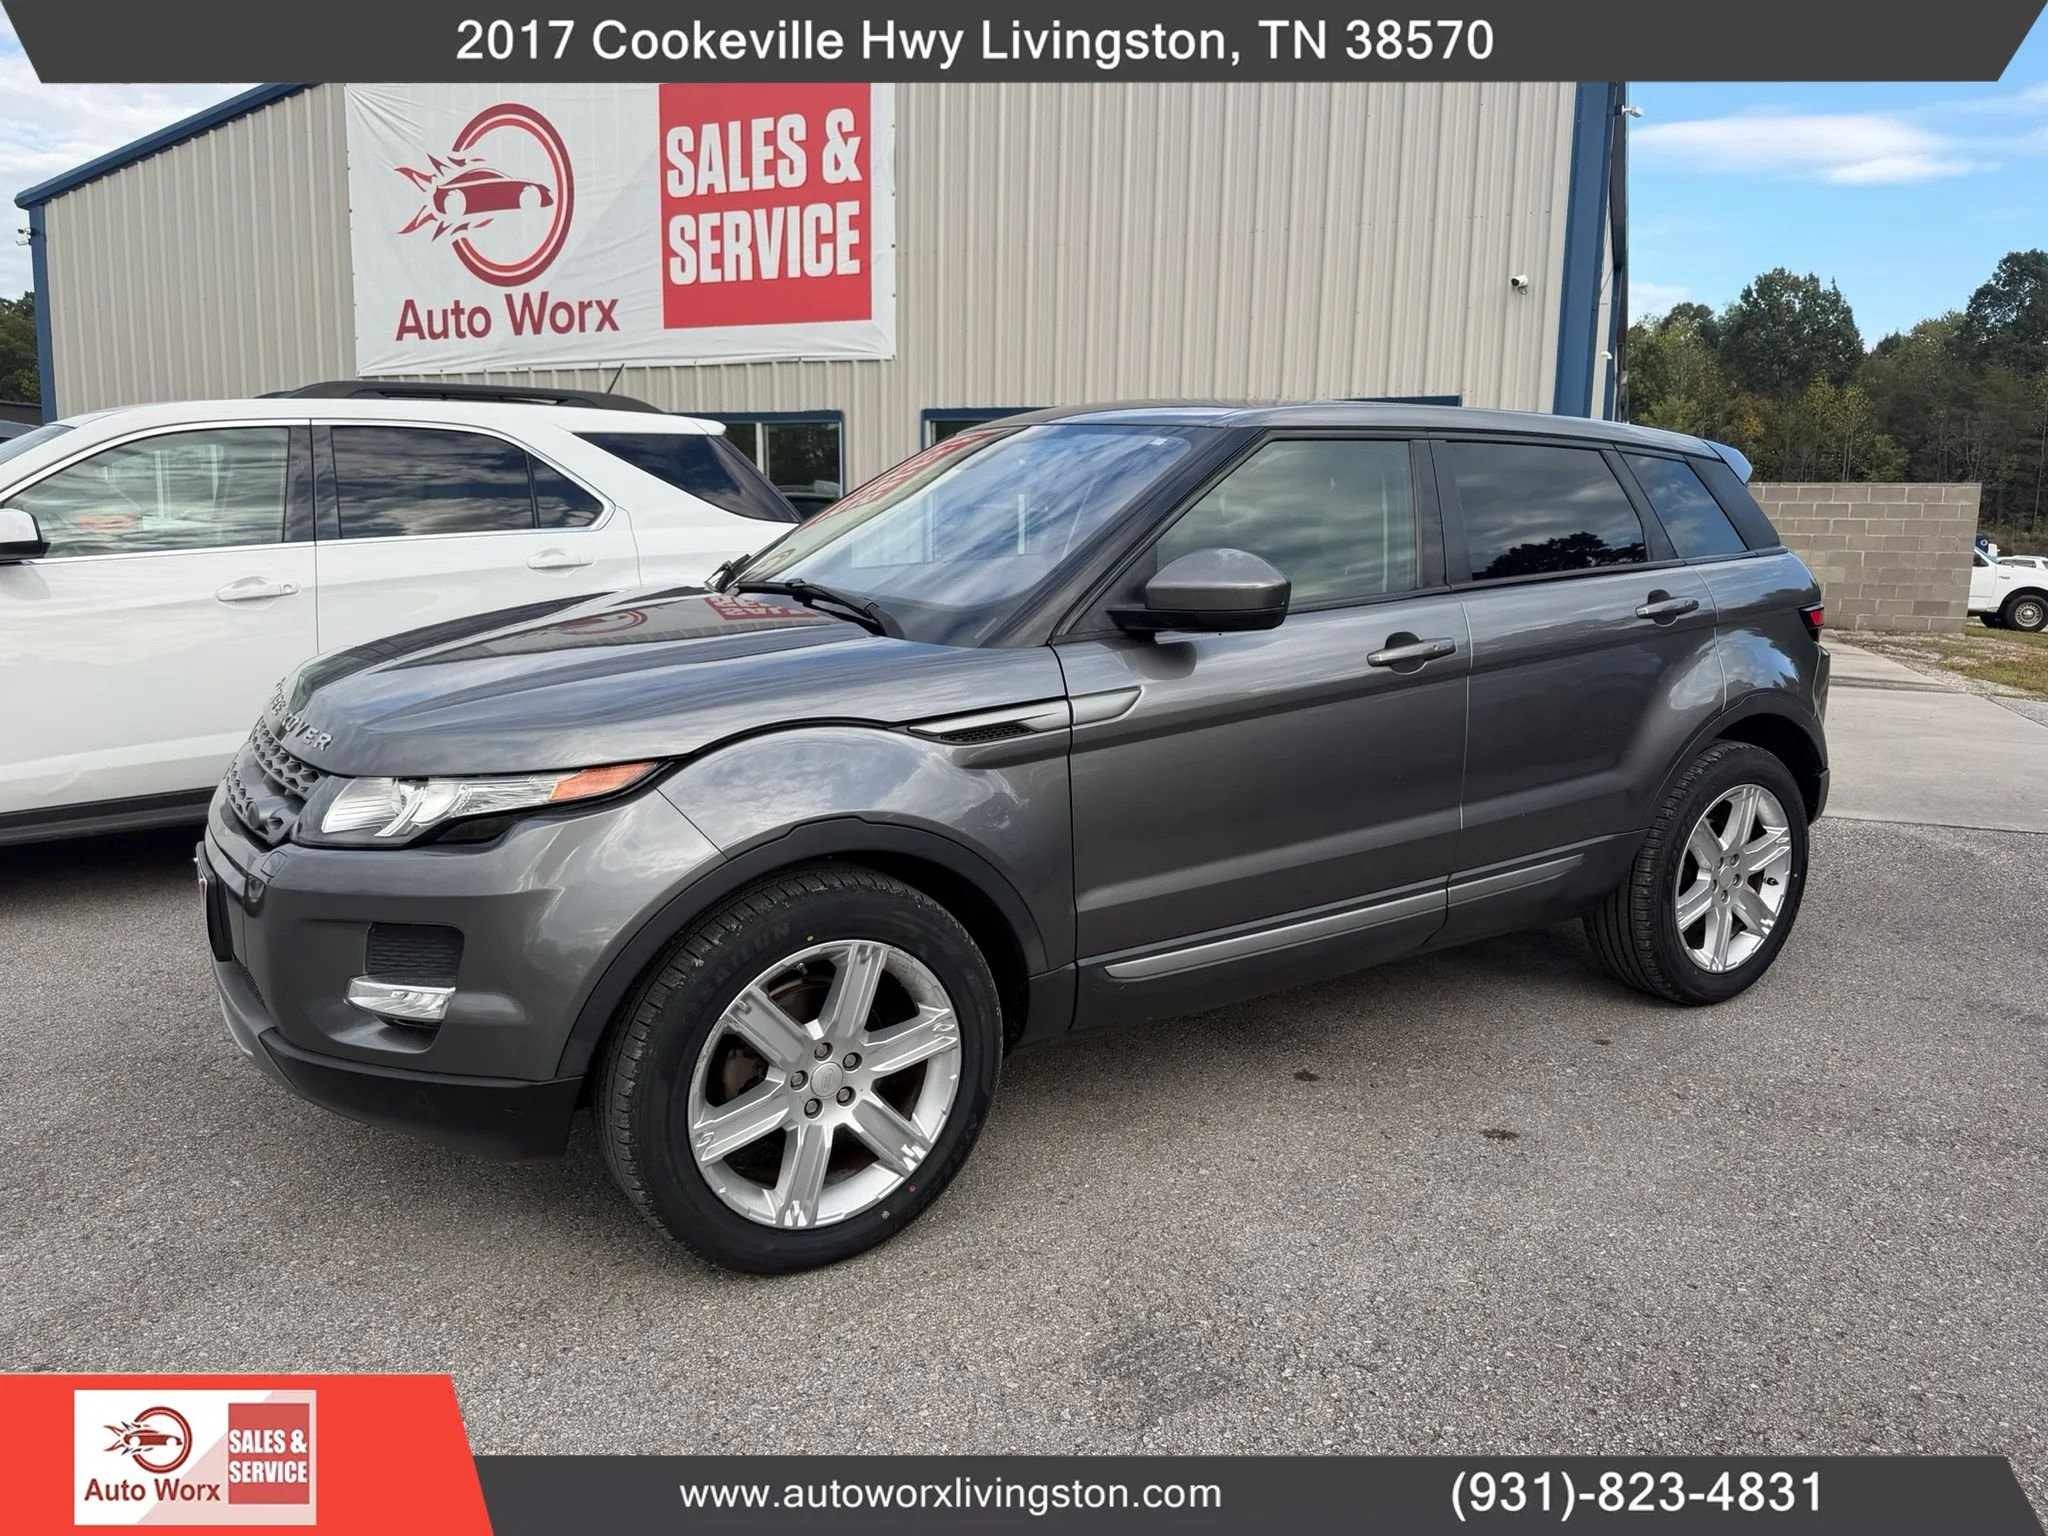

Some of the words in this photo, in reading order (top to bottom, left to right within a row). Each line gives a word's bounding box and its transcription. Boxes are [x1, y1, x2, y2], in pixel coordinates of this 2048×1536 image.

[667, 113, 807, 198] SALES
[822, 107, 863, 185] &
[669, 201, 862, 286] SERVICE
[395, 298, 492, 341] Auto
[504, 291, 621, 337] Worx
